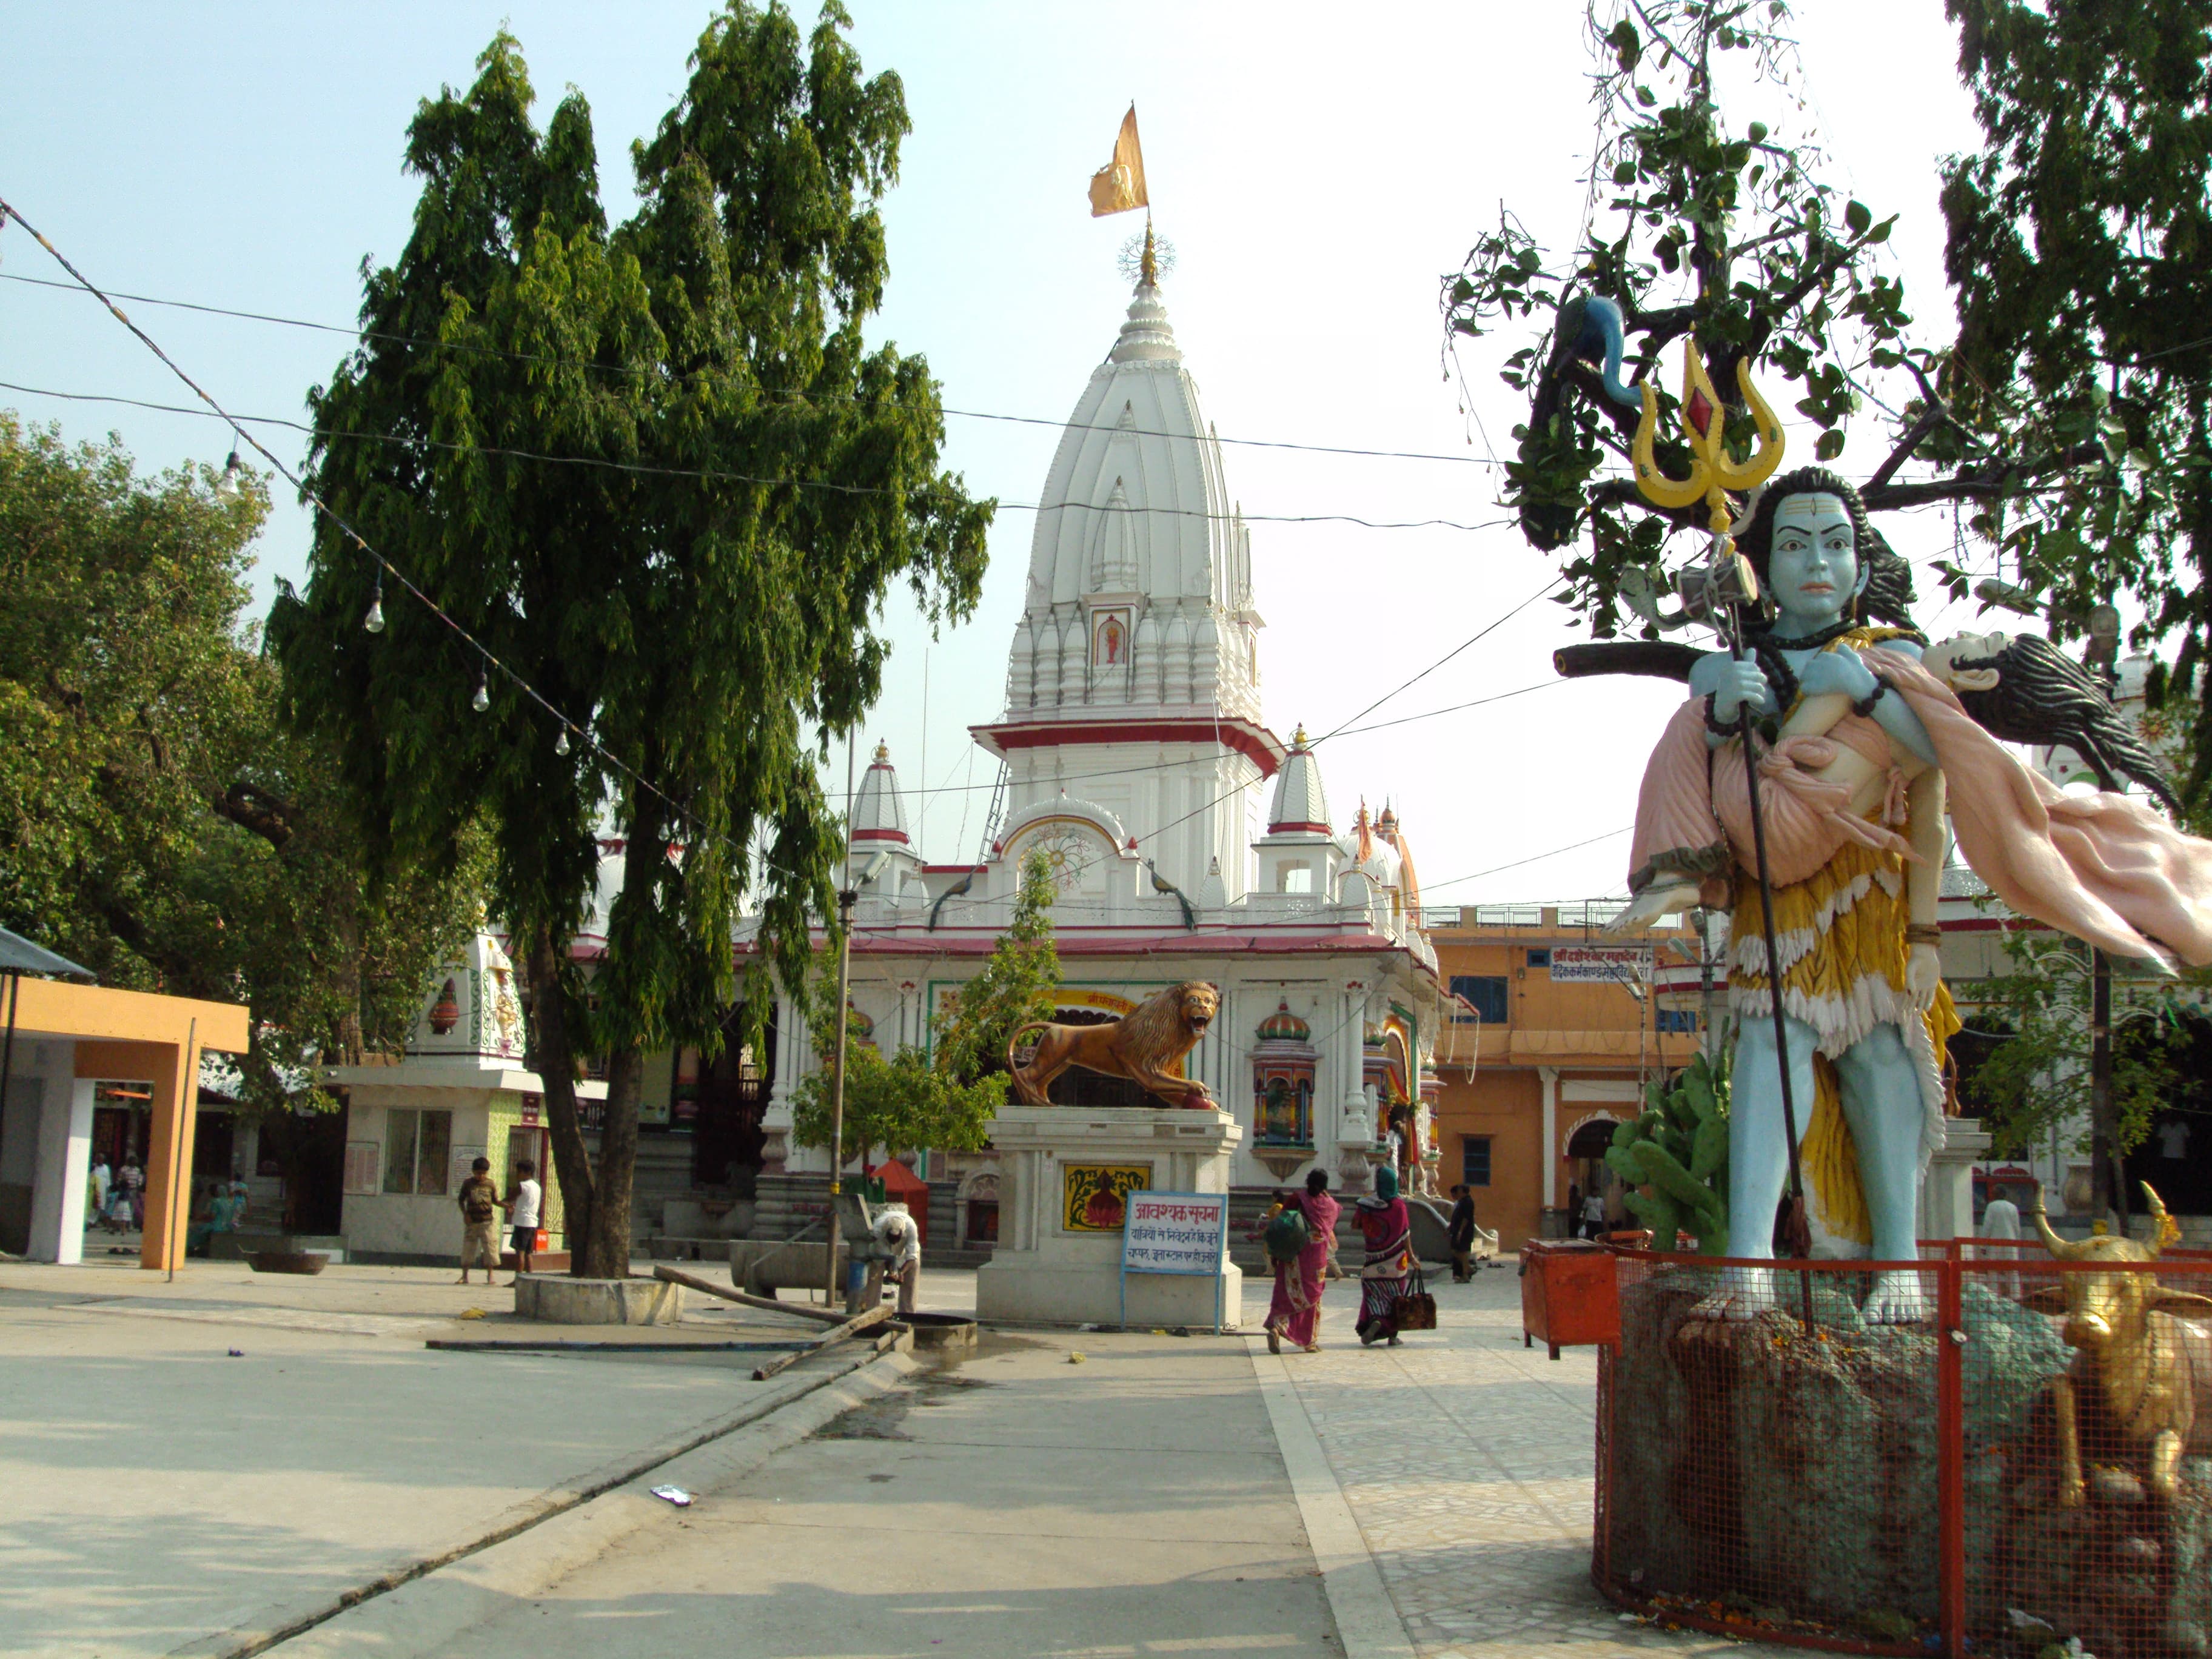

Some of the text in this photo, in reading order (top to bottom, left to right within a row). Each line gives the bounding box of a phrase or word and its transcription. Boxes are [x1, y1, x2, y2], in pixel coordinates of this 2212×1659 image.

[1553, 948, 1567, 962] श्री
[1606, 950, 1637, 963] महादेव
[1135, 1203, 1220, 1225] आवश्यक सूचना
[1131, 1225, 1156, 1241] यात्रियों
[1158, 1227, 1165, 1241] से
[1167, 1228, 1190, 1243] निवेदन
[1206, 1229, 1219, 1246] जूते
